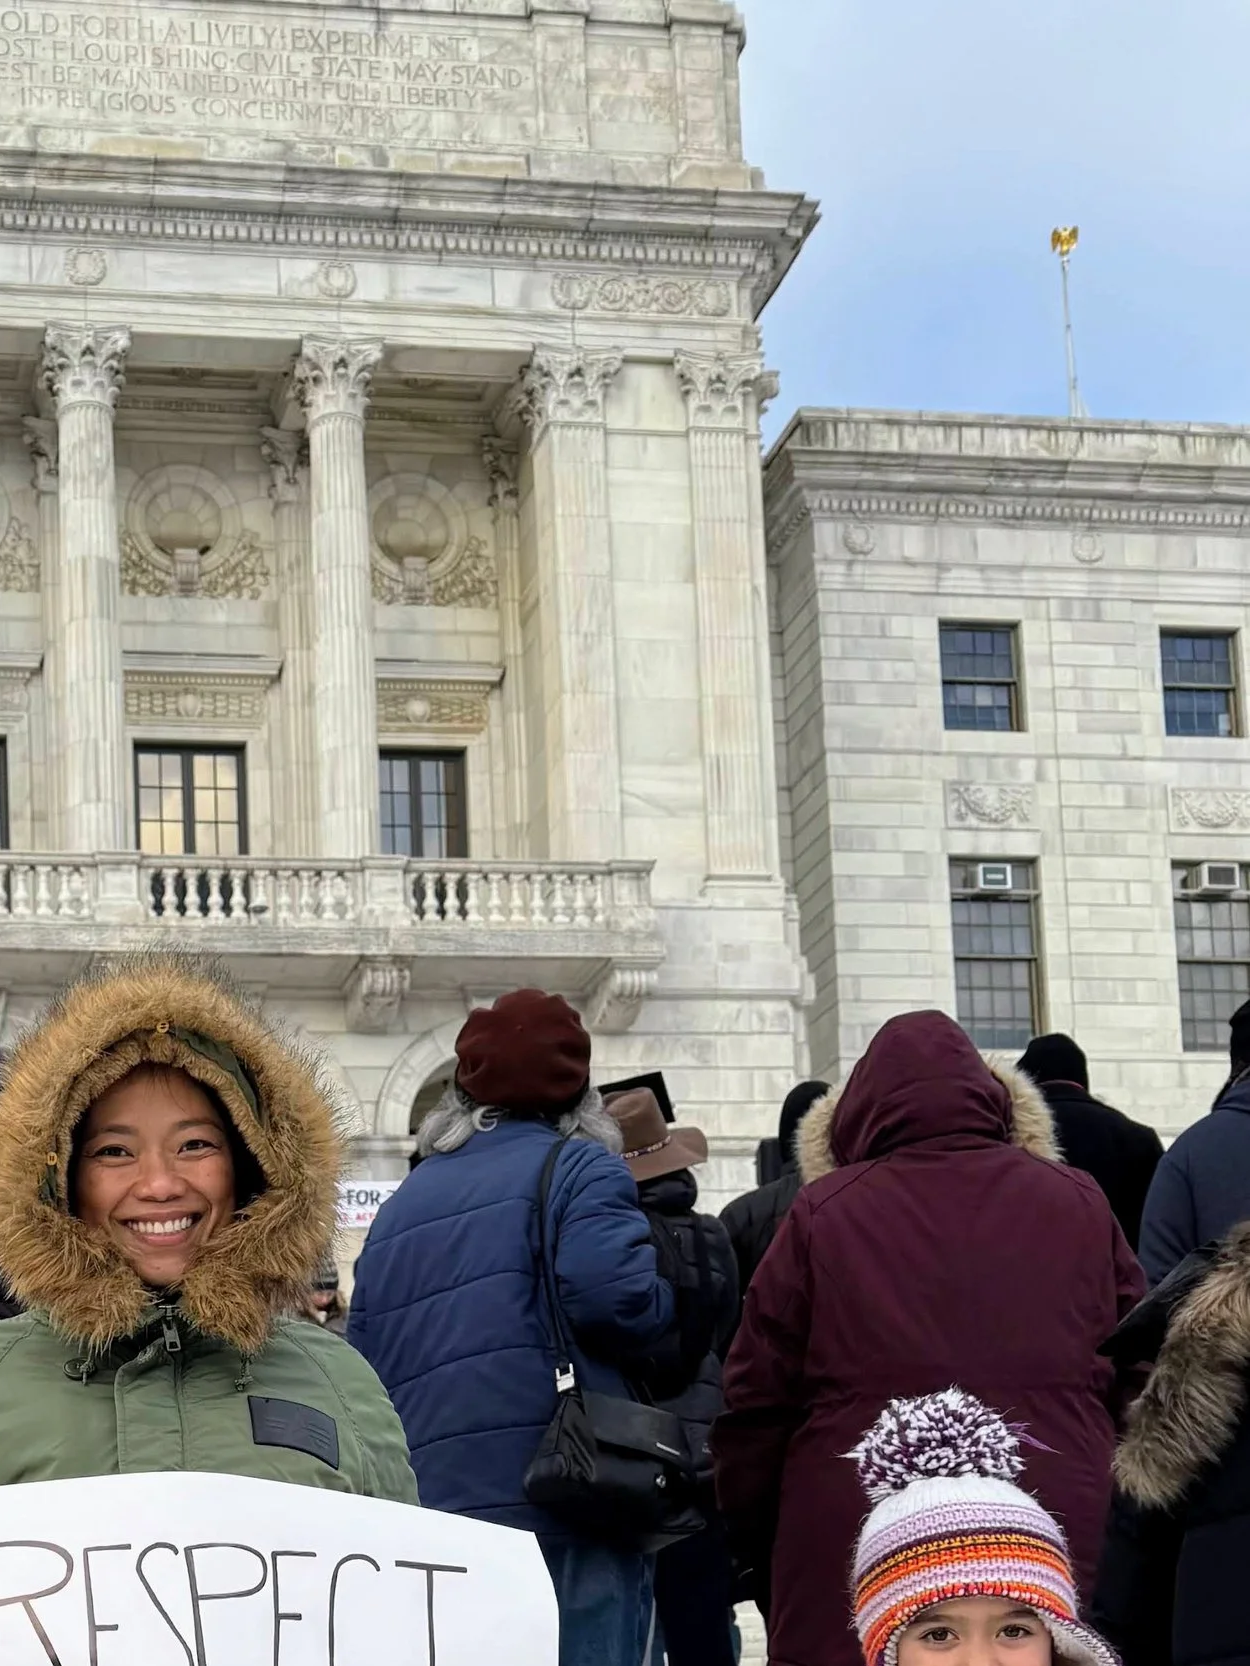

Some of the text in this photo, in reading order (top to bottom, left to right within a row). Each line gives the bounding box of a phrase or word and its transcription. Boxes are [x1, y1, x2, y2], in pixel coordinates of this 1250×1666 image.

[70, 14, 155, 43] FORTH
[164, 20, 182, 44] A
[190, 21, 277, 49] LIVELY
[290, 28, 467, 60] EXPERIMENT
[53, 40, 228, 70] FLOURISHING
[237, 51, 300, 75] CIVIL
[311, 57, 382, 79] STATE
[393, 61, 443, 83] MAY
[451, 65, 523, 89] STAND
[21, 87, 389, 126] IN RELIGIOUS CONCERNMENTS
[53, 65, 81, 84] BE
[92, 68, 239, 94] MAINTAINED
[250, 77, 308, 99] WITH
[322, 80, 380, 101] FULL
[387, 85, 477, 108] LIBERTY
[347, 1189, 381, 1206] FOR
